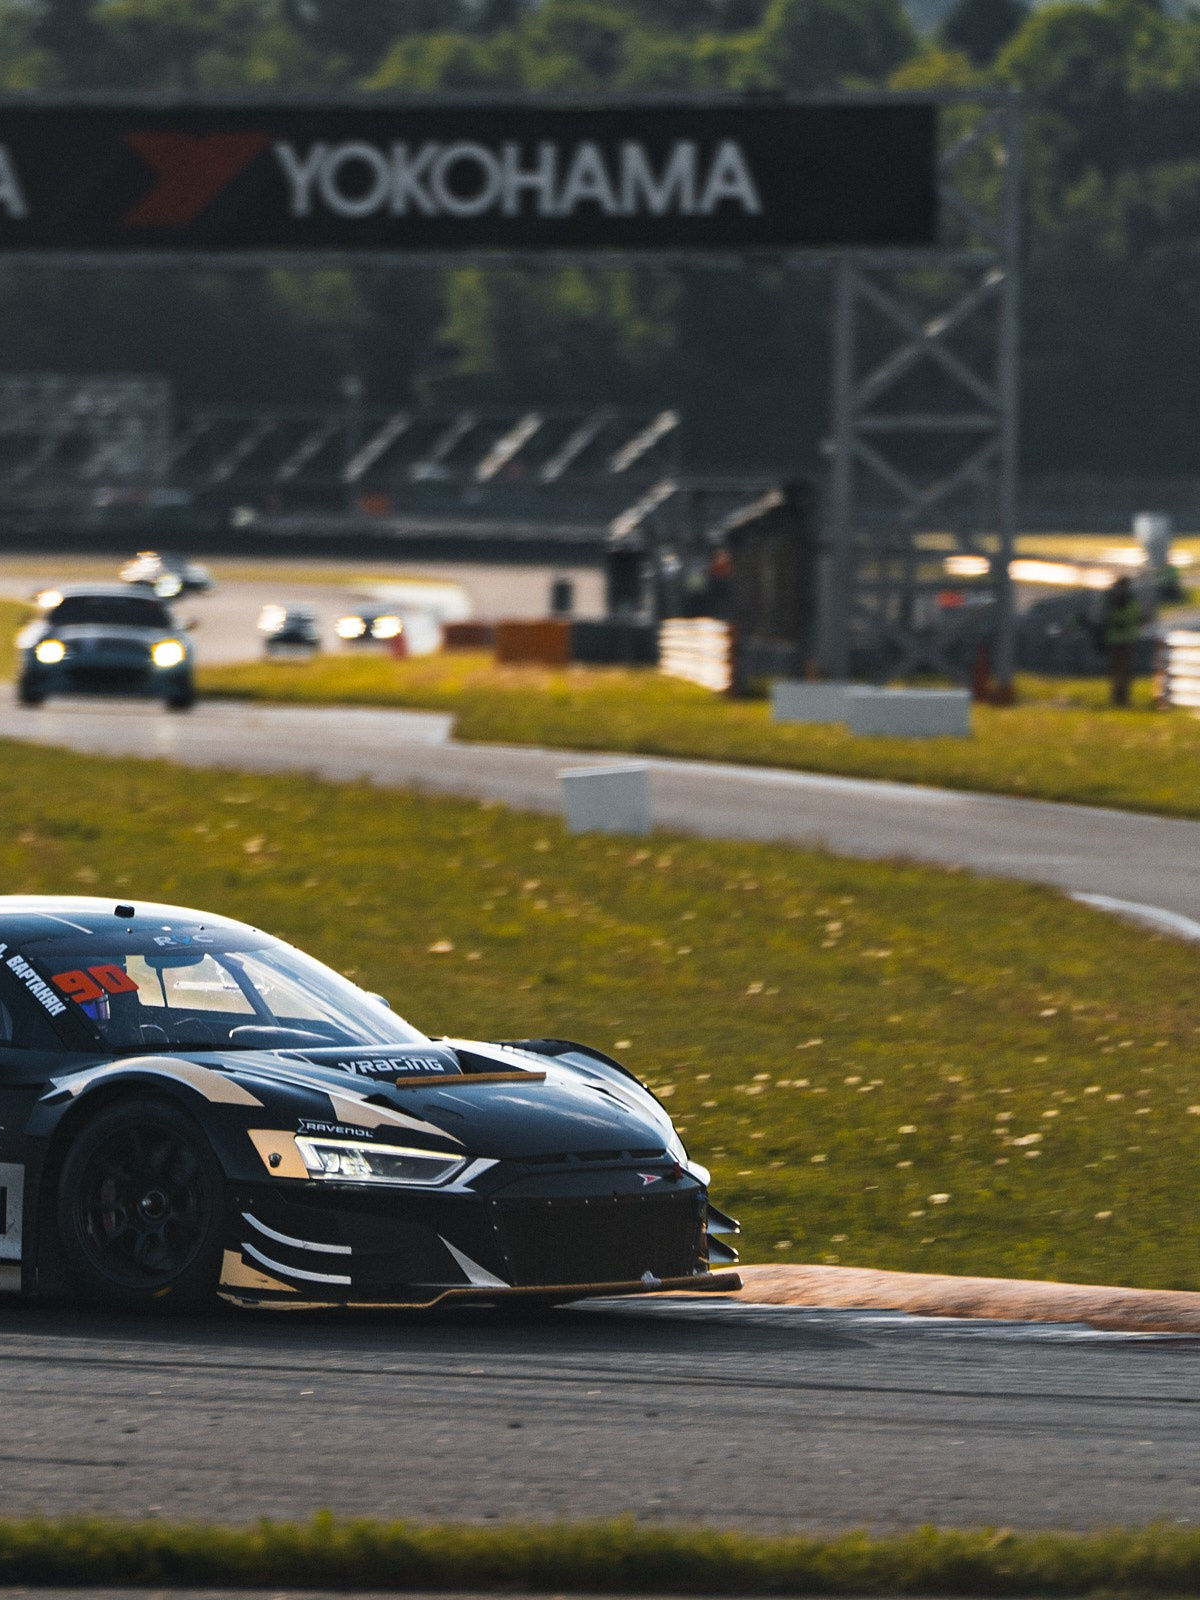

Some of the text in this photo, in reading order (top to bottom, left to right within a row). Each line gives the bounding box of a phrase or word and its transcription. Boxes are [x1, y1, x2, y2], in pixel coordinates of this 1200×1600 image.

[273, 139, 762, 217] YOKOHAMA
[5, 954, 68, 1017] ВАРТАНЯН
[51, 963, 140, 1004] 90
[305, 1122, 373, 1138] RAVENOL
